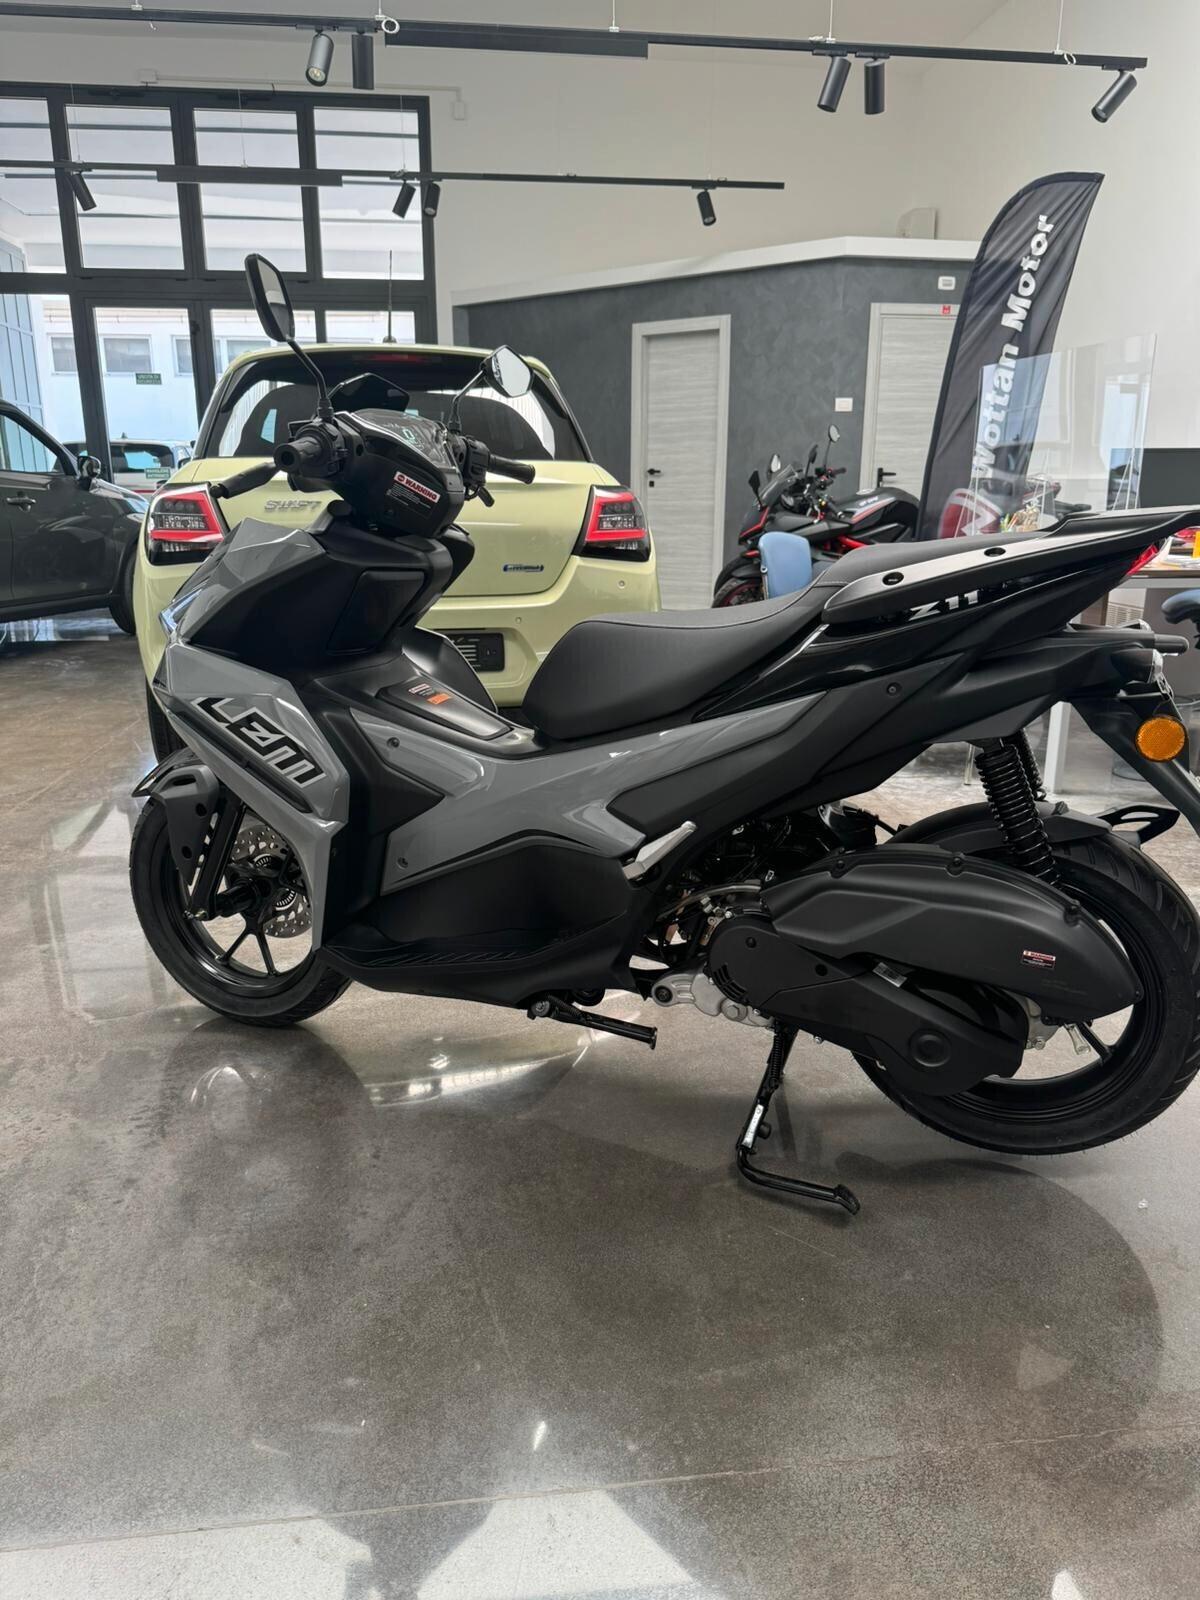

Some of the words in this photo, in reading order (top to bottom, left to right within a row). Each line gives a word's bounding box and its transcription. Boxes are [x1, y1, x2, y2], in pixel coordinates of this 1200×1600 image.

[971, 343, 1020, 478] Wottan
[1001, 214, 1055, 332] Motor
[405, 478, 438, 501] WARNING
[264, 500, 322, 512] SWIFT
